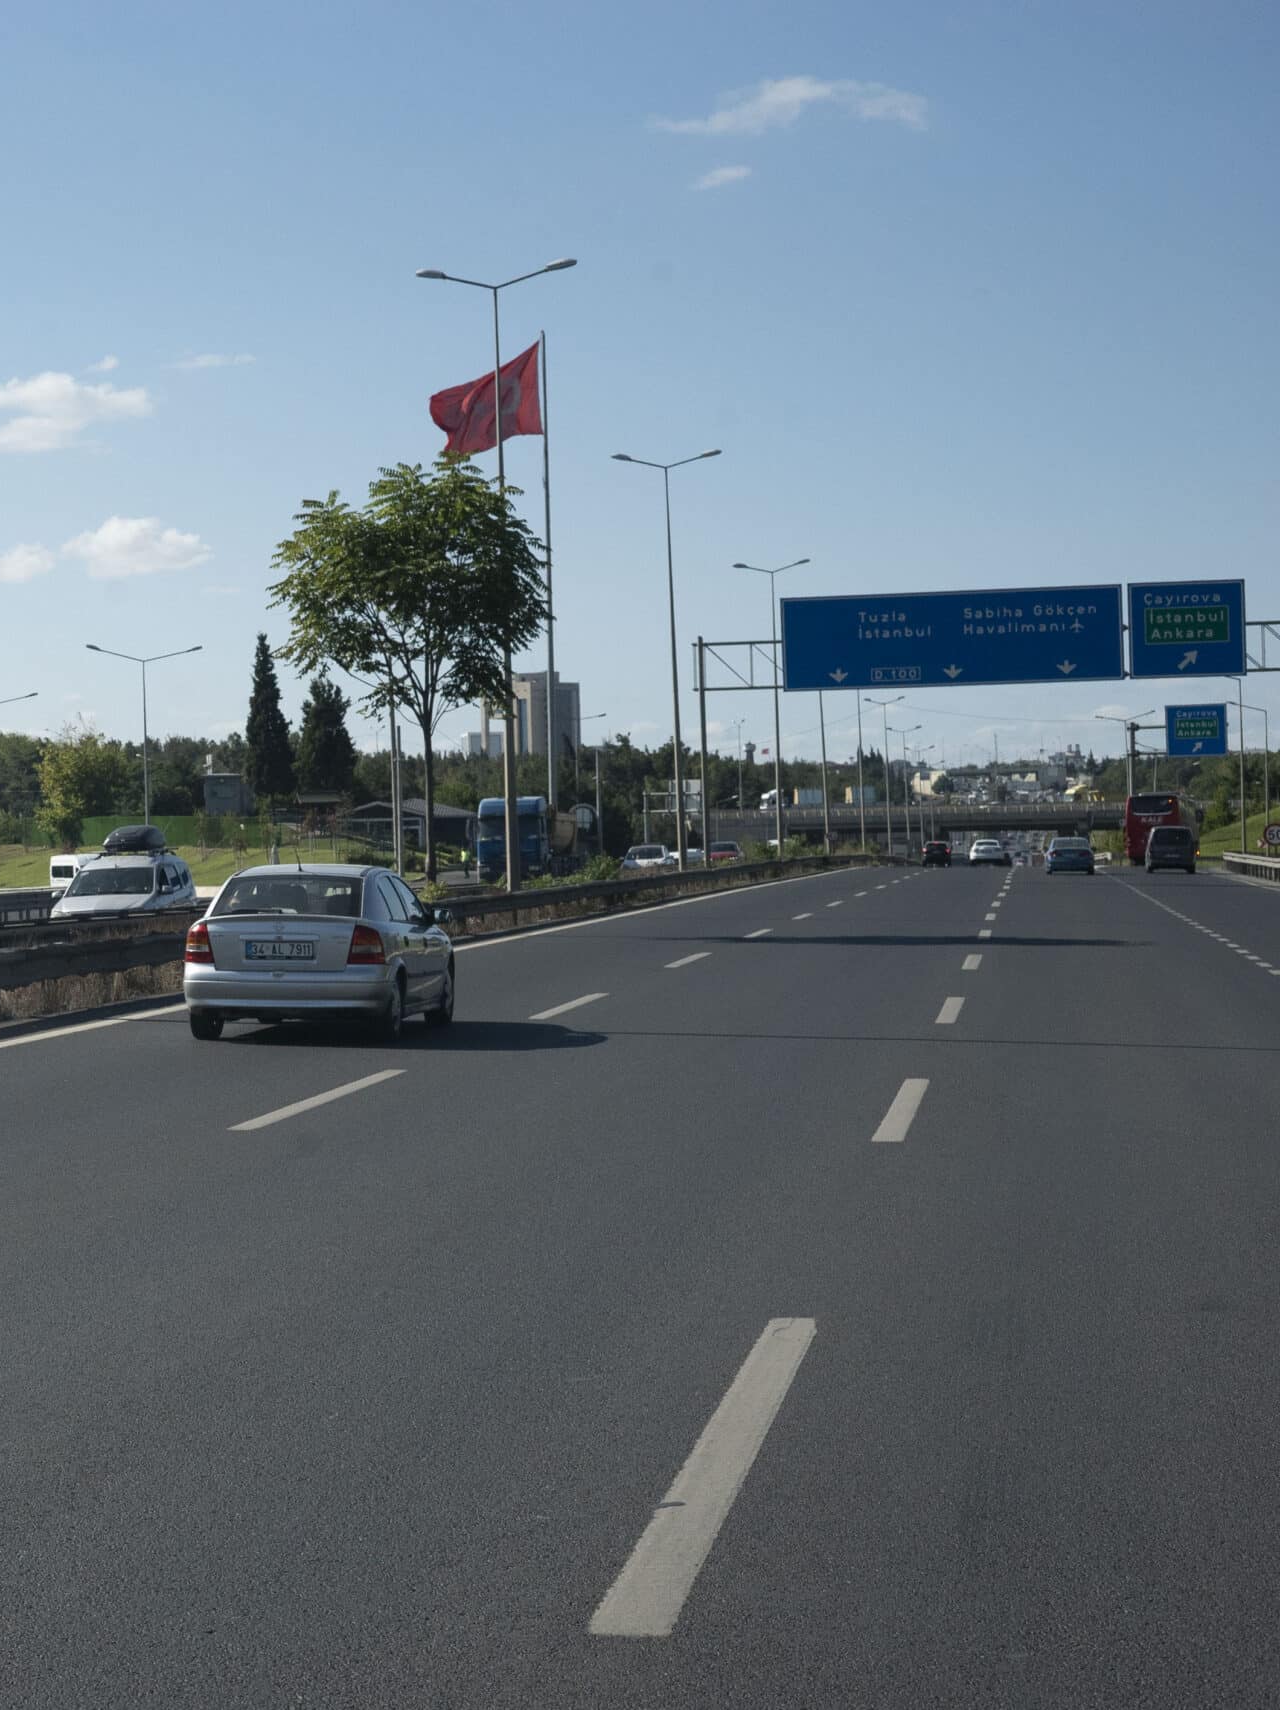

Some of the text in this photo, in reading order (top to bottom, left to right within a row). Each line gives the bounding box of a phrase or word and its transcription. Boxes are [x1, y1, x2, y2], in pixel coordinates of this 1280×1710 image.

[858, 610, 906, 623] Tuzla
[963, 603, 1097, 619] Sabiha Gökçen
[963, 621, 1066, 635] Havalimanı
[1151, 627, 1214, 640] Ankara
[252, 943, 312, 955] 34 AL 7911
